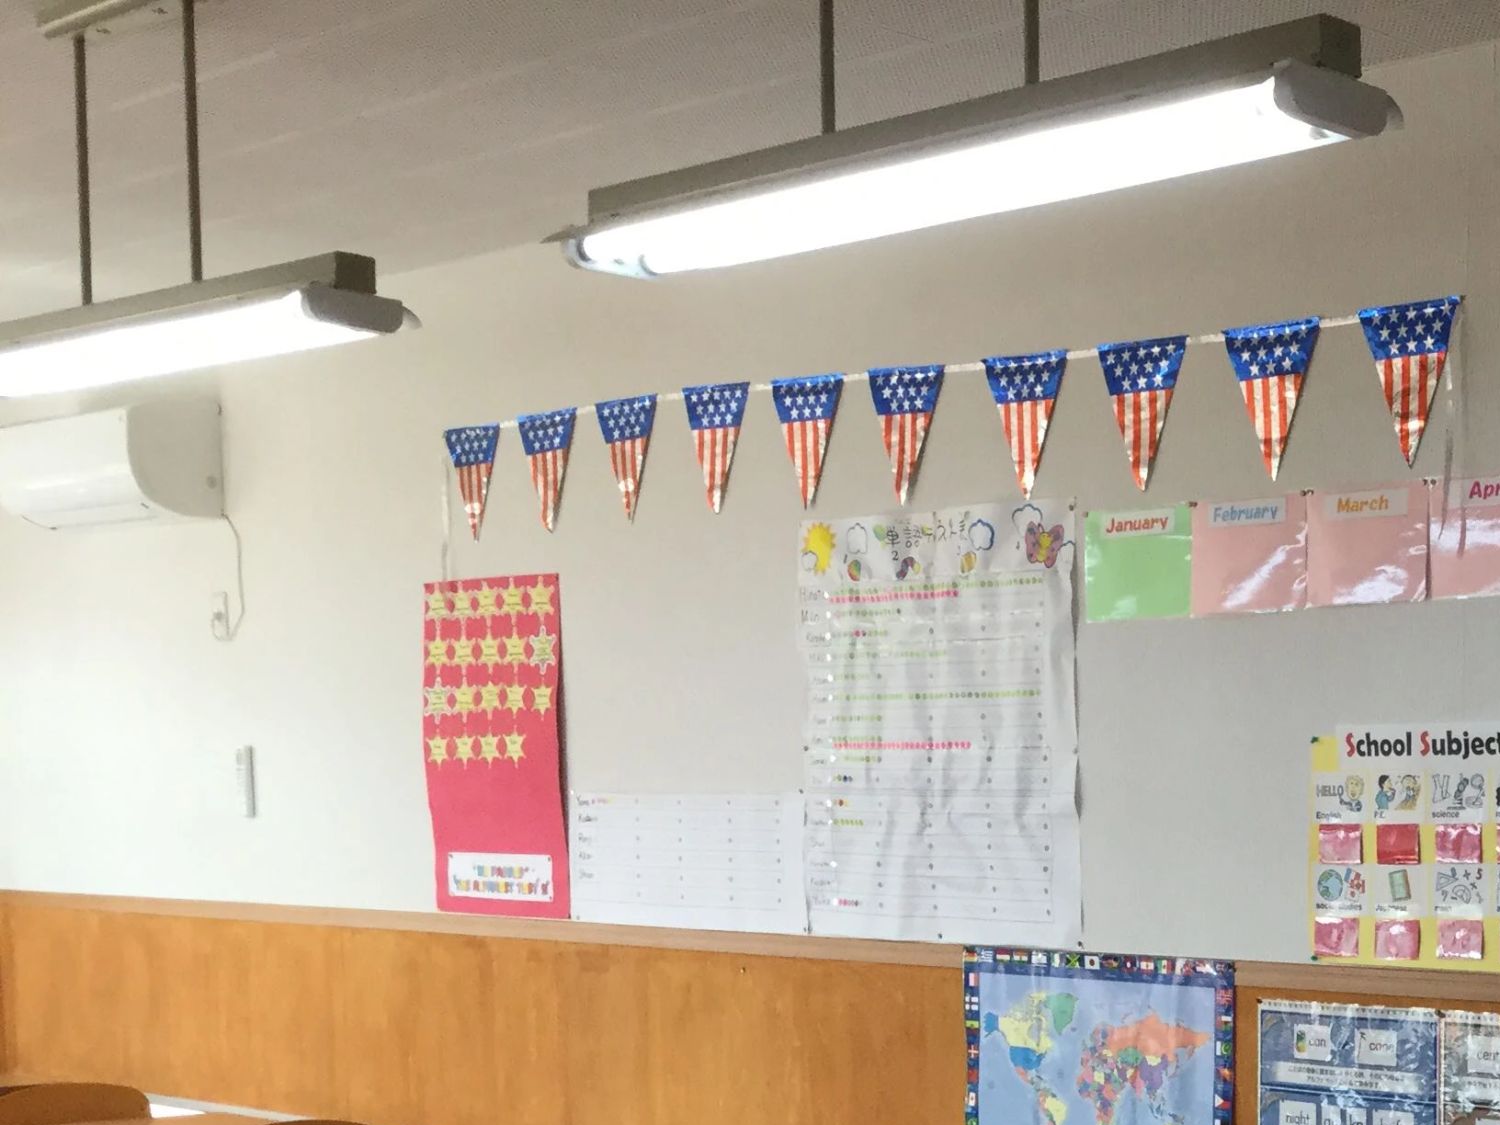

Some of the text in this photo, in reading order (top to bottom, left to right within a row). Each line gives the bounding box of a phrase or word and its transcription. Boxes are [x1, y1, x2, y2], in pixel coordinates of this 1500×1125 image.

[1337, 495, 1389, 512] March
[1213, 504, 1278, 522] February
[1106, 517, 1168, 534] January
[1346, 732, 1412, 757] School
[1316, 784, 1344, 797] HELLO
[1432, 810, 1459, 818] science
